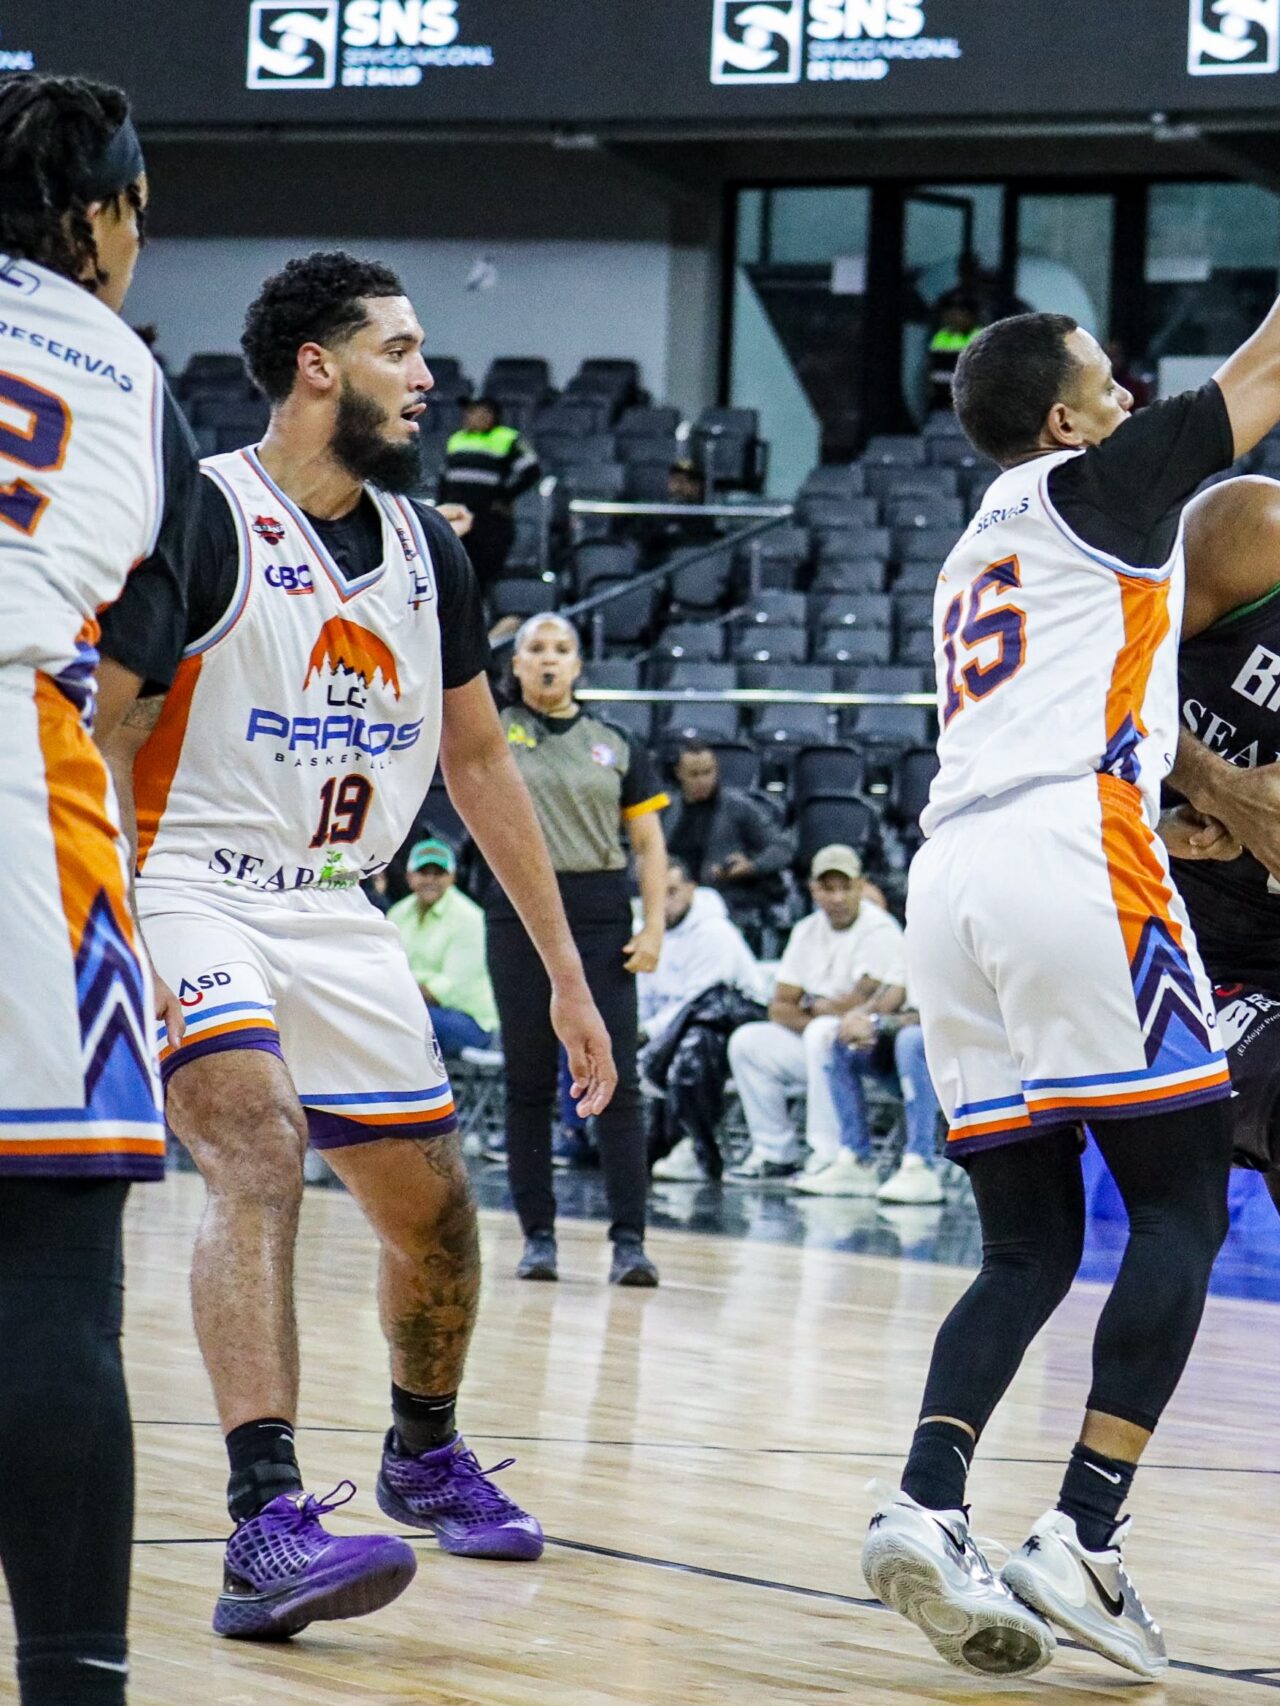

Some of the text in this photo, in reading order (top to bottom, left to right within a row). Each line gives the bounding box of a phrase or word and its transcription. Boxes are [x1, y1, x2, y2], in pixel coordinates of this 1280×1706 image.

[342, 0, 459, 47] SNS
[806, 0, 925, 40] SNS
[943, 554, 1028, 732] 15
[308, 773, 374, 849] 19
